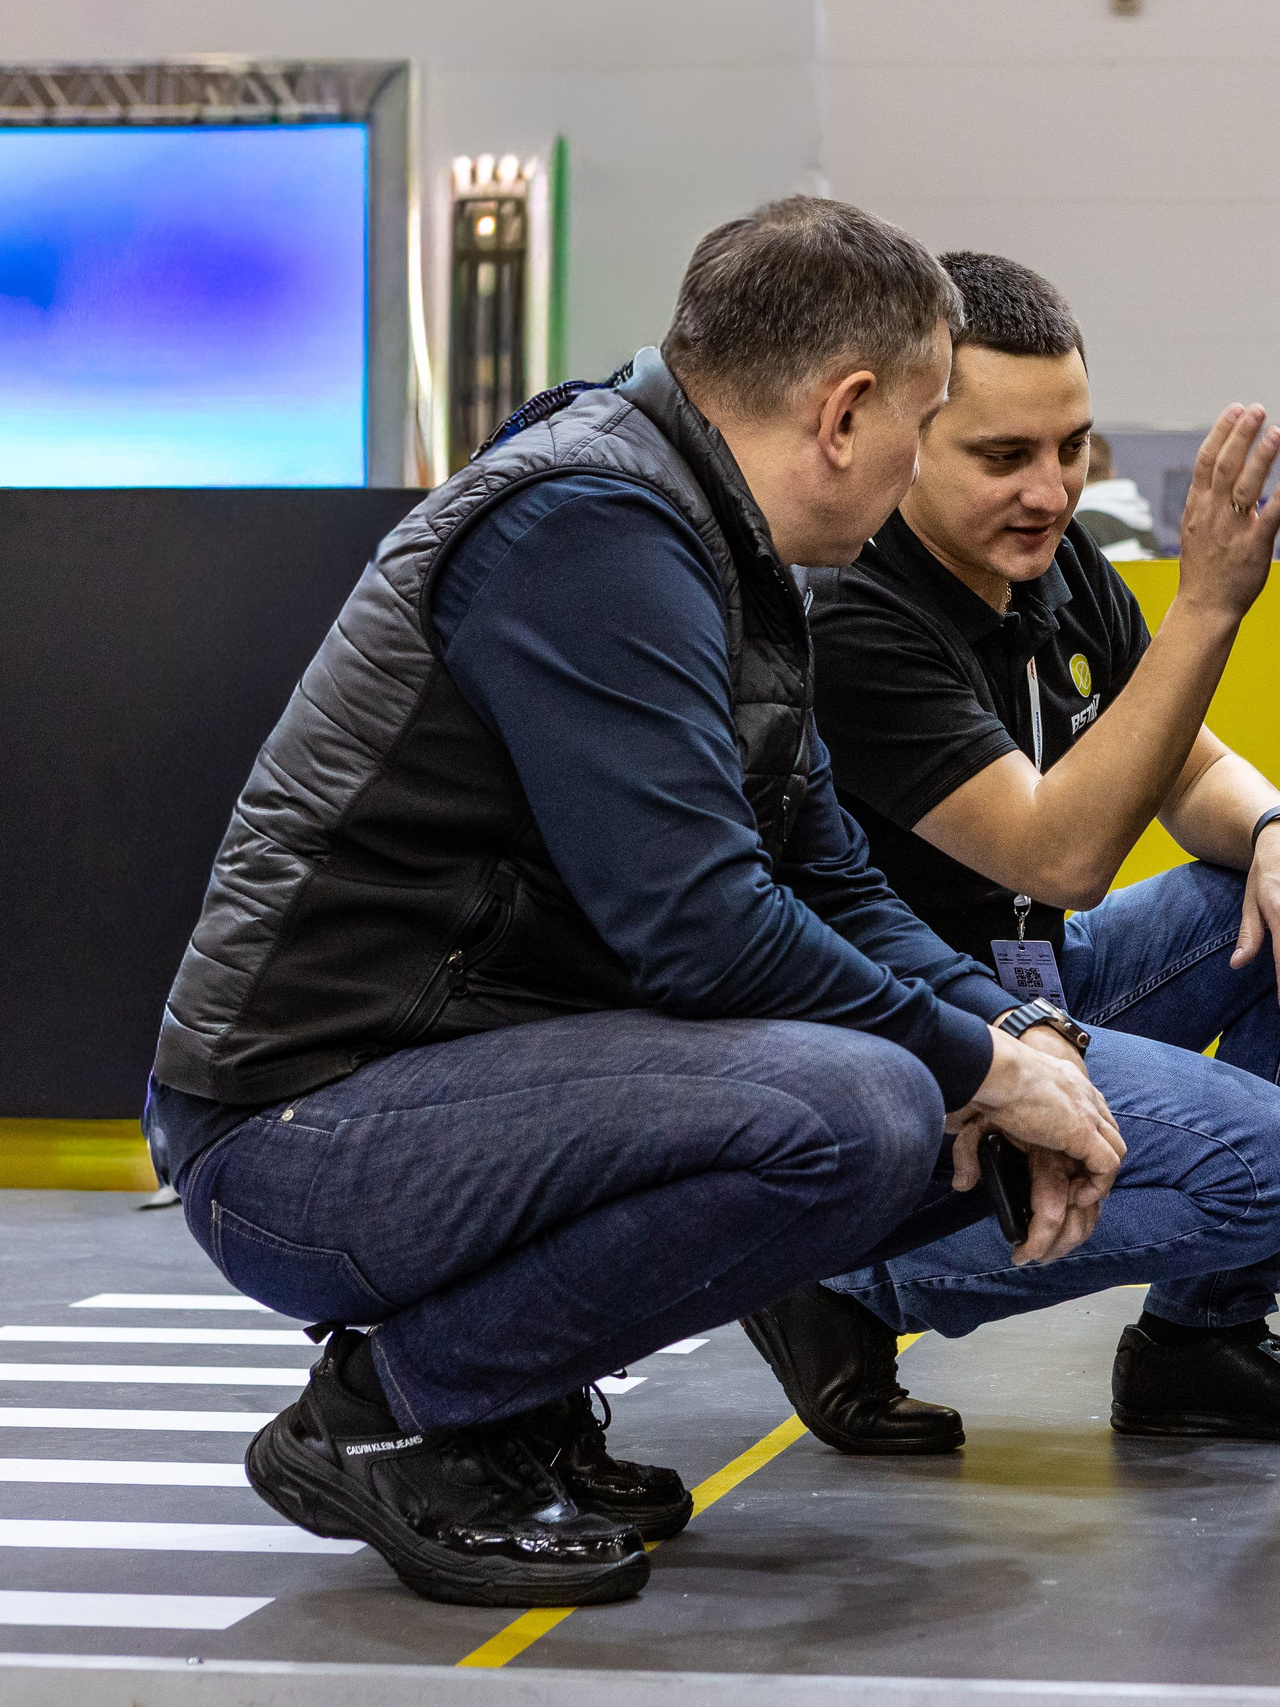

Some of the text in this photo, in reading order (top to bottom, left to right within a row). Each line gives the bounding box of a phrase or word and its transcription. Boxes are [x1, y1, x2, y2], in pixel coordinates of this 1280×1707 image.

[346, 1434, 423, 1456] CALVIN KLEIN JEANS
